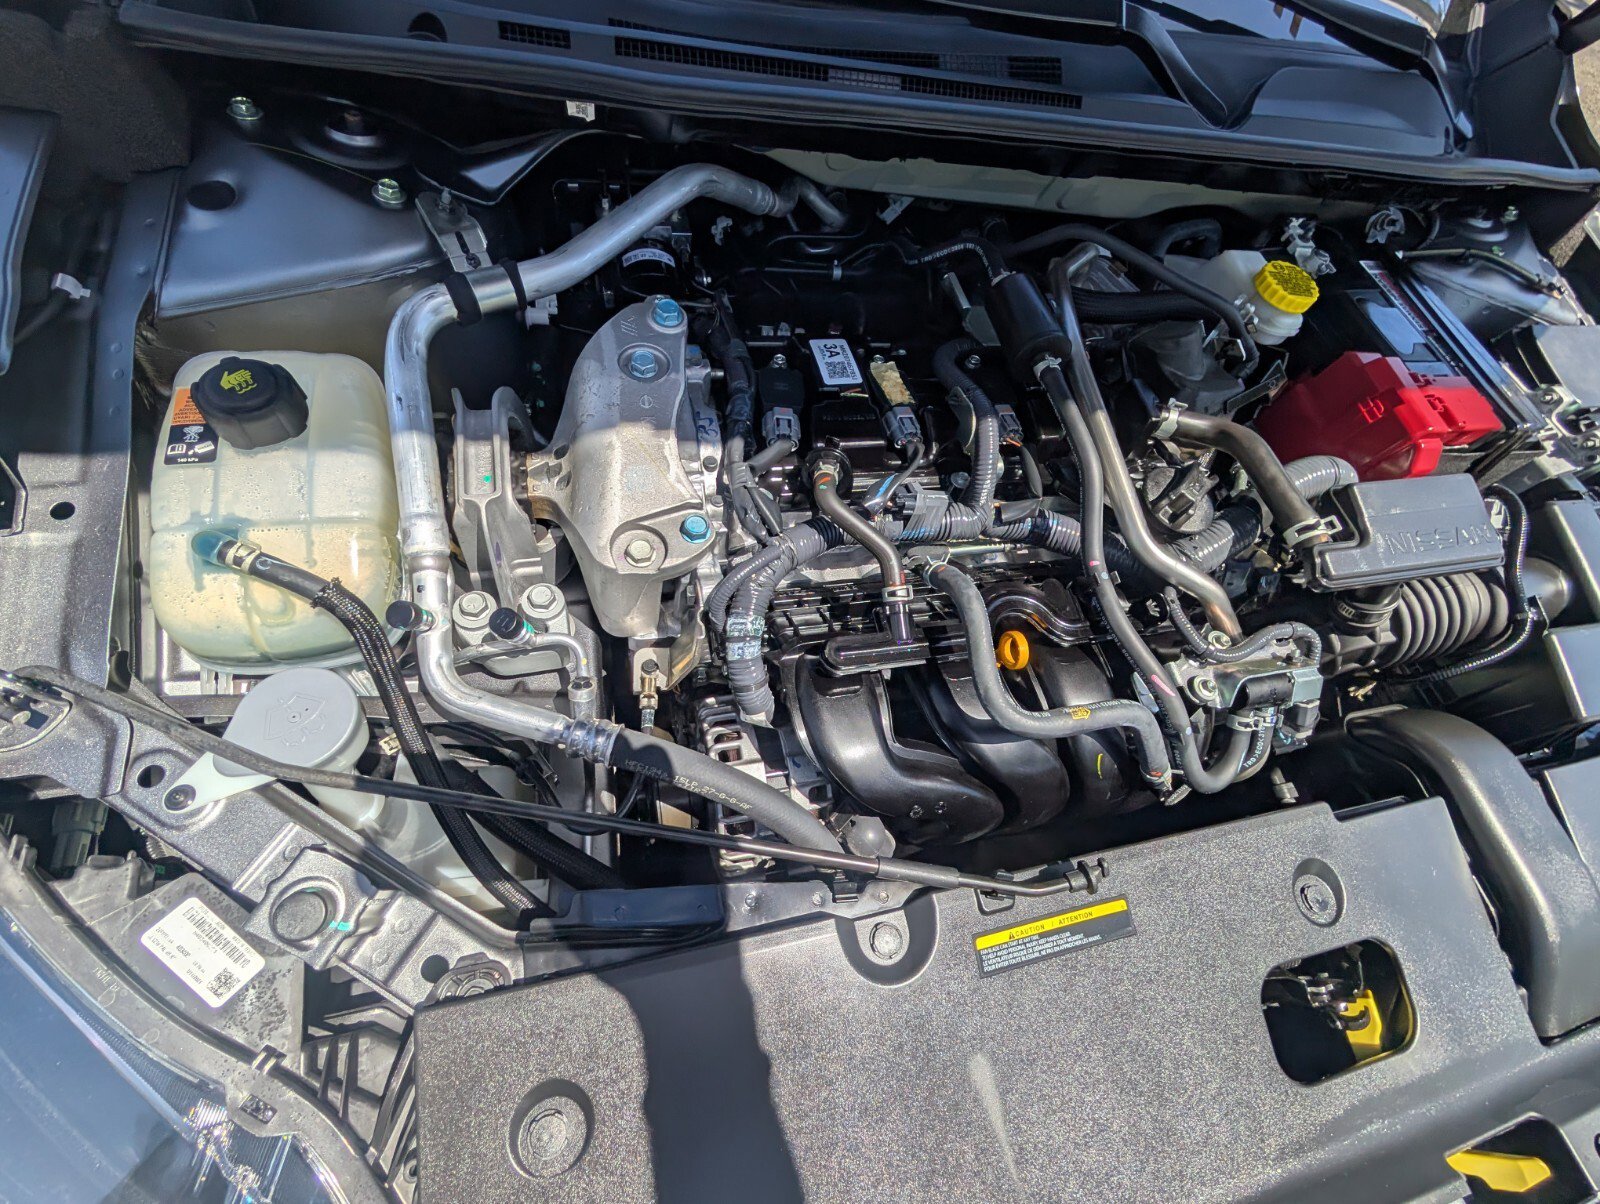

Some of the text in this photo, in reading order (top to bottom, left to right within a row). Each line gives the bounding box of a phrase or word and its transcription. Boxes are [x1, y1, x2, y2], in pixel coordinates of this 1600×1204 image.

[823, 343, 841, 359] 3A
[1384, 523, 1494, 554] NISSAN
[1015, 924, 1045, 937] CAUTION
[1058, 911, 1093, 925] ATTENTION
